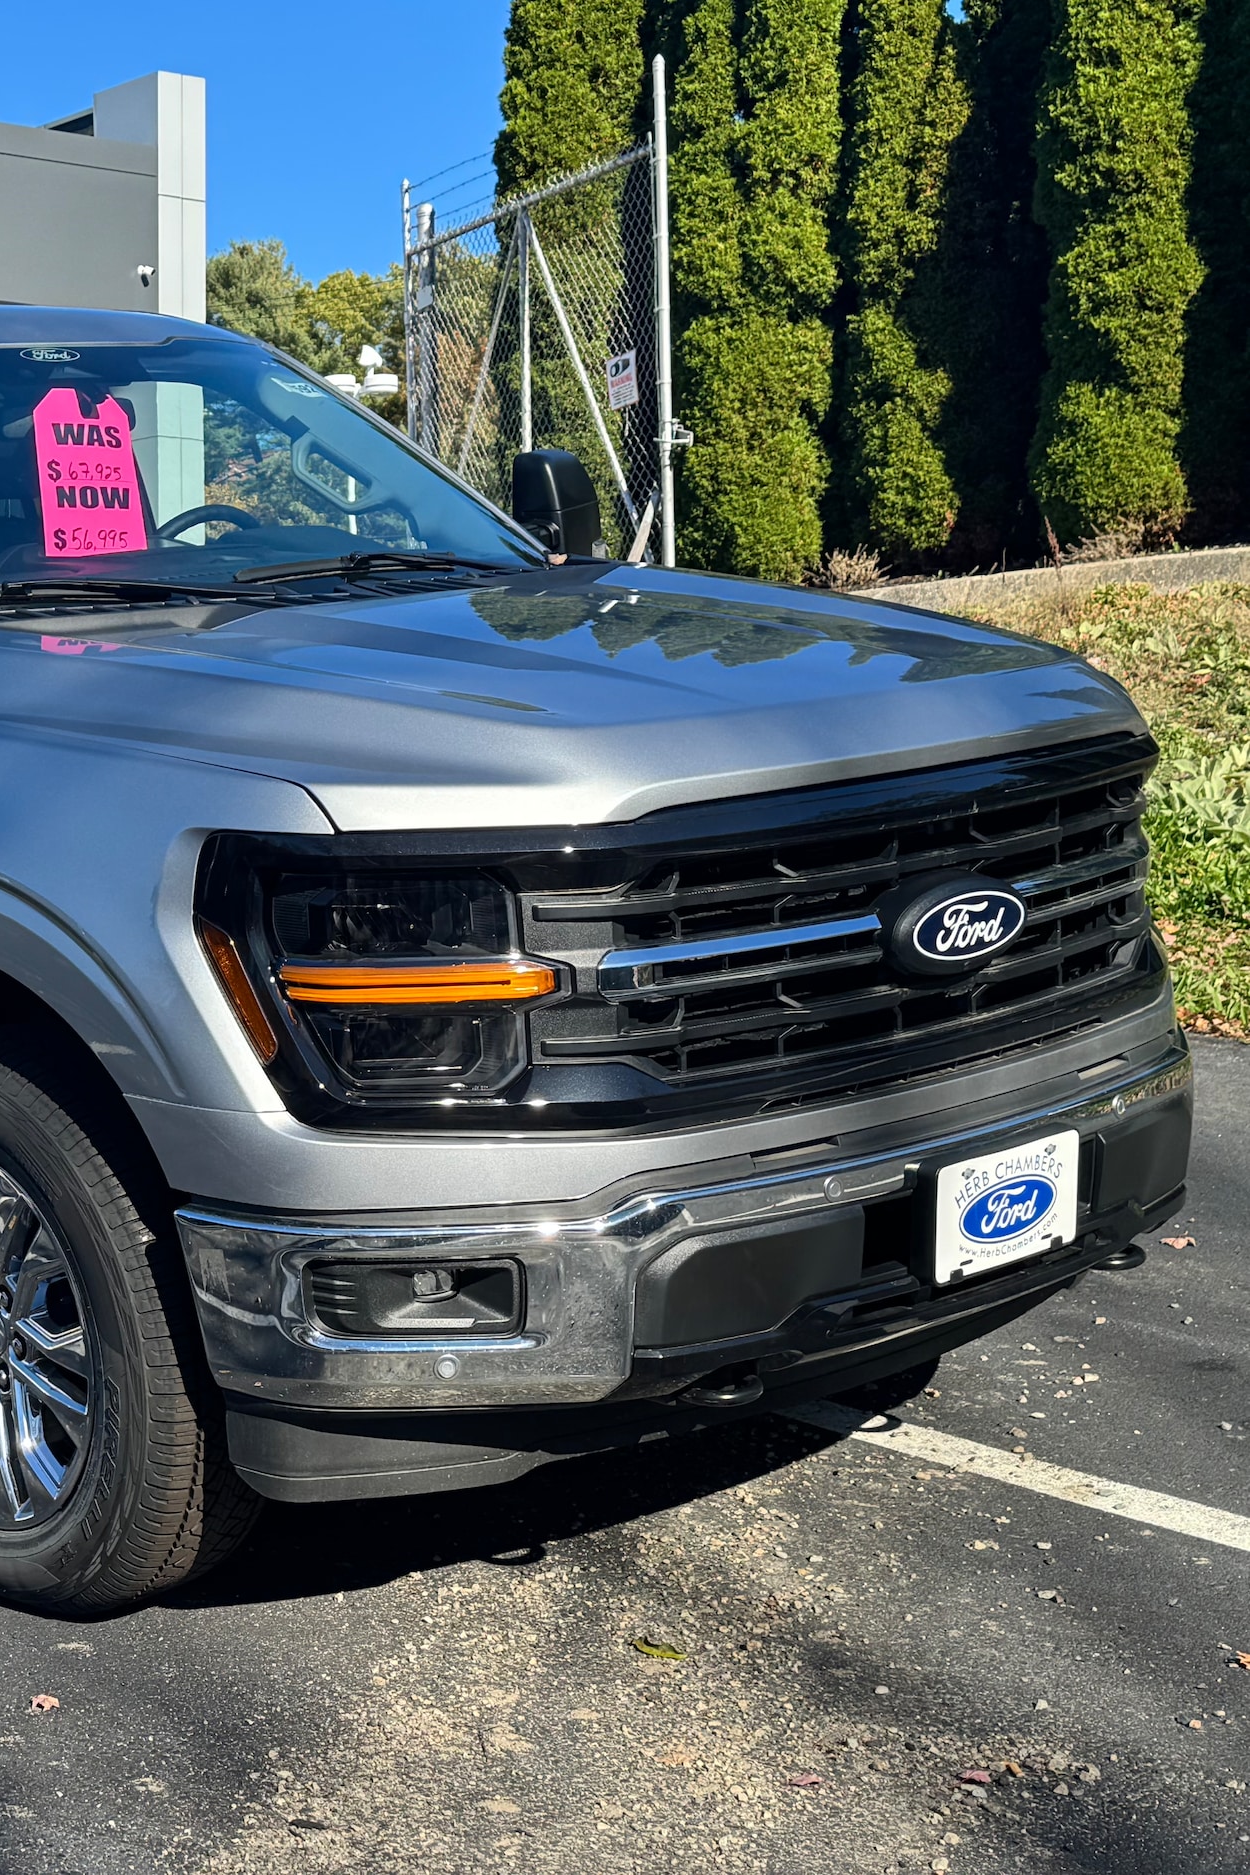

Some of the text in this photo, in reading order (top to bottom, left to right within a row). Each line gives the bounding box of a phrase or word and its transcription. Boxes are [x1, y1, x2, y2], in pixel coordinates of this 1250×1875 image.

[32, 349, 71, 360] Ford
[51, 422, 122, 448] WAS
[55, 485, 130, 510] NOW
[935, 900, 1006, 953] Ford
[954, 1154, 1064, 1210] HERB CHAMBERS
[980, 1184, 1039, 1235] Ford
[958, 1212, 1058, 1258] www.HerbChambers.com
